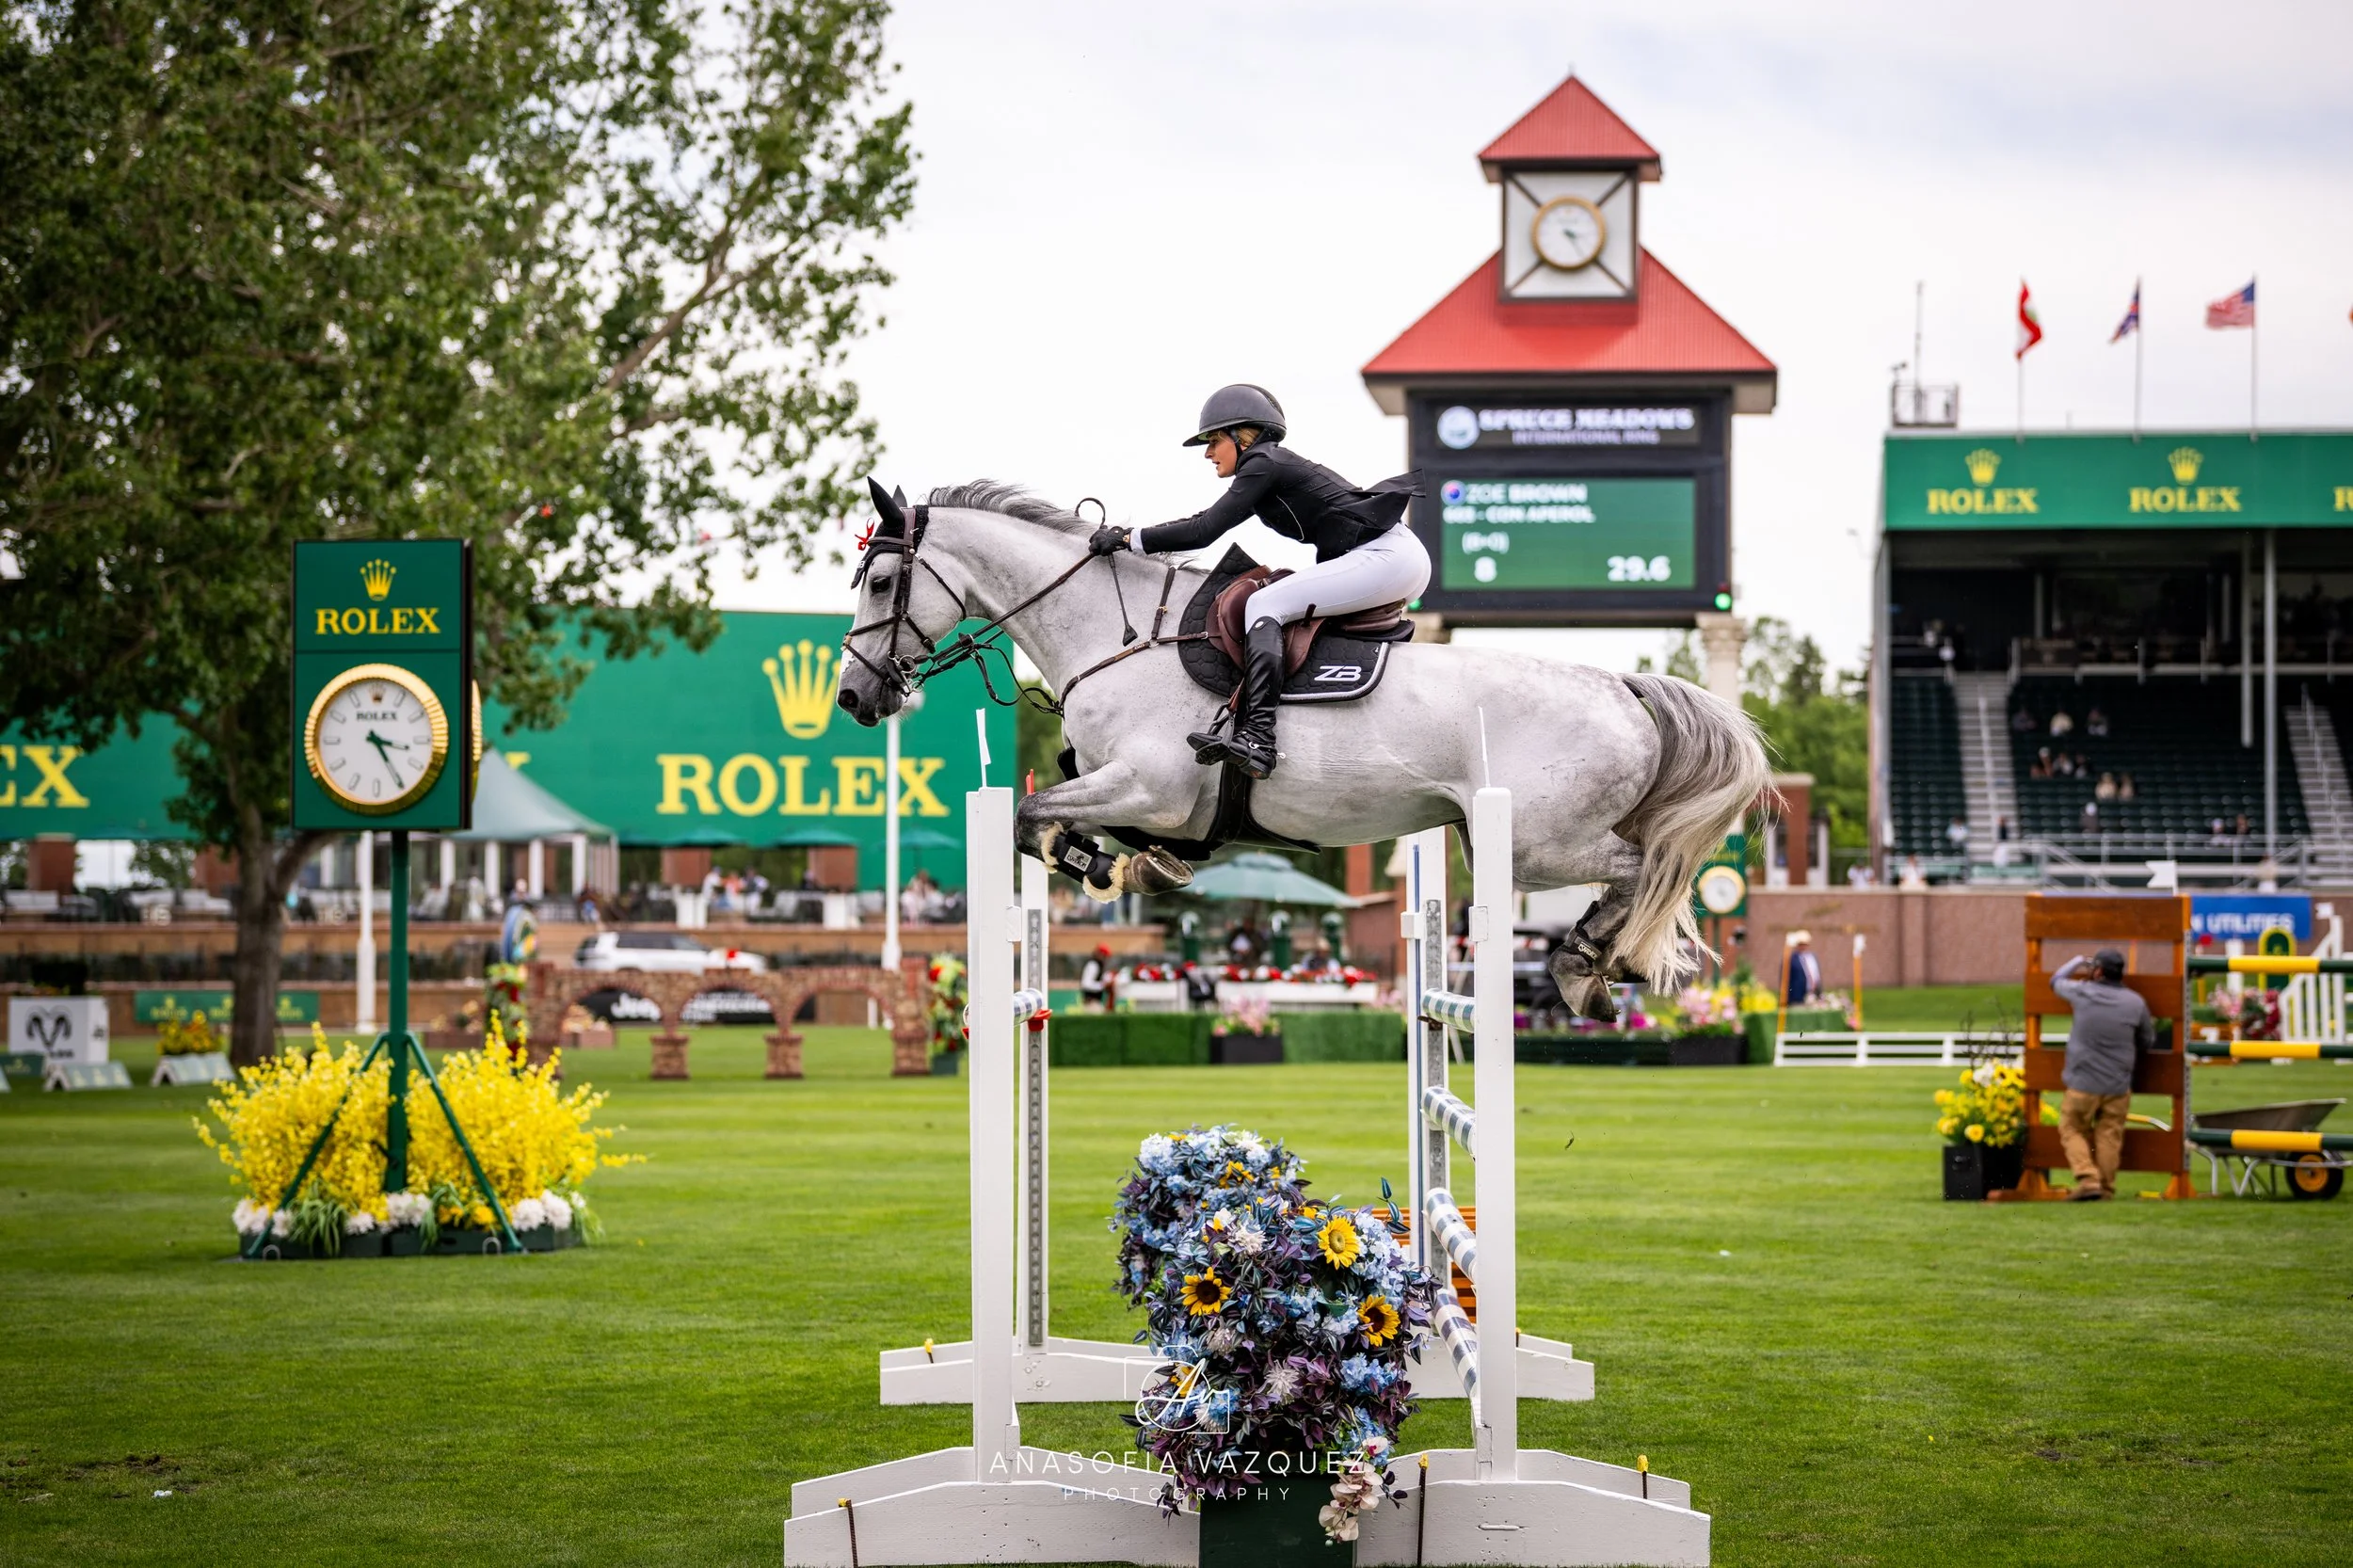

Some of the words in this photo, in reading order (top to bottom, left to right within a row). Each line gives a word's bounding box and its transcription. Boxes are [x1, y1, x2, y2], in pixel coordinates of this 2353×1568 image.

[1465, 484, 1506, 504] ZOE
[1509, 484, 1587, 504] BROWN
[1927, 488, 2039, 515] ROLEX
[2129, 486, 2242, 513] ROLEX
[1607, 555, 1672, 582] 29.6
[315, 608, 440, 634] ROLEX
[1314, 665, 1362, 681] ZB
[356, 712, 397, 721] ROLEX
[656, 753, 951, 817] ROLEX
